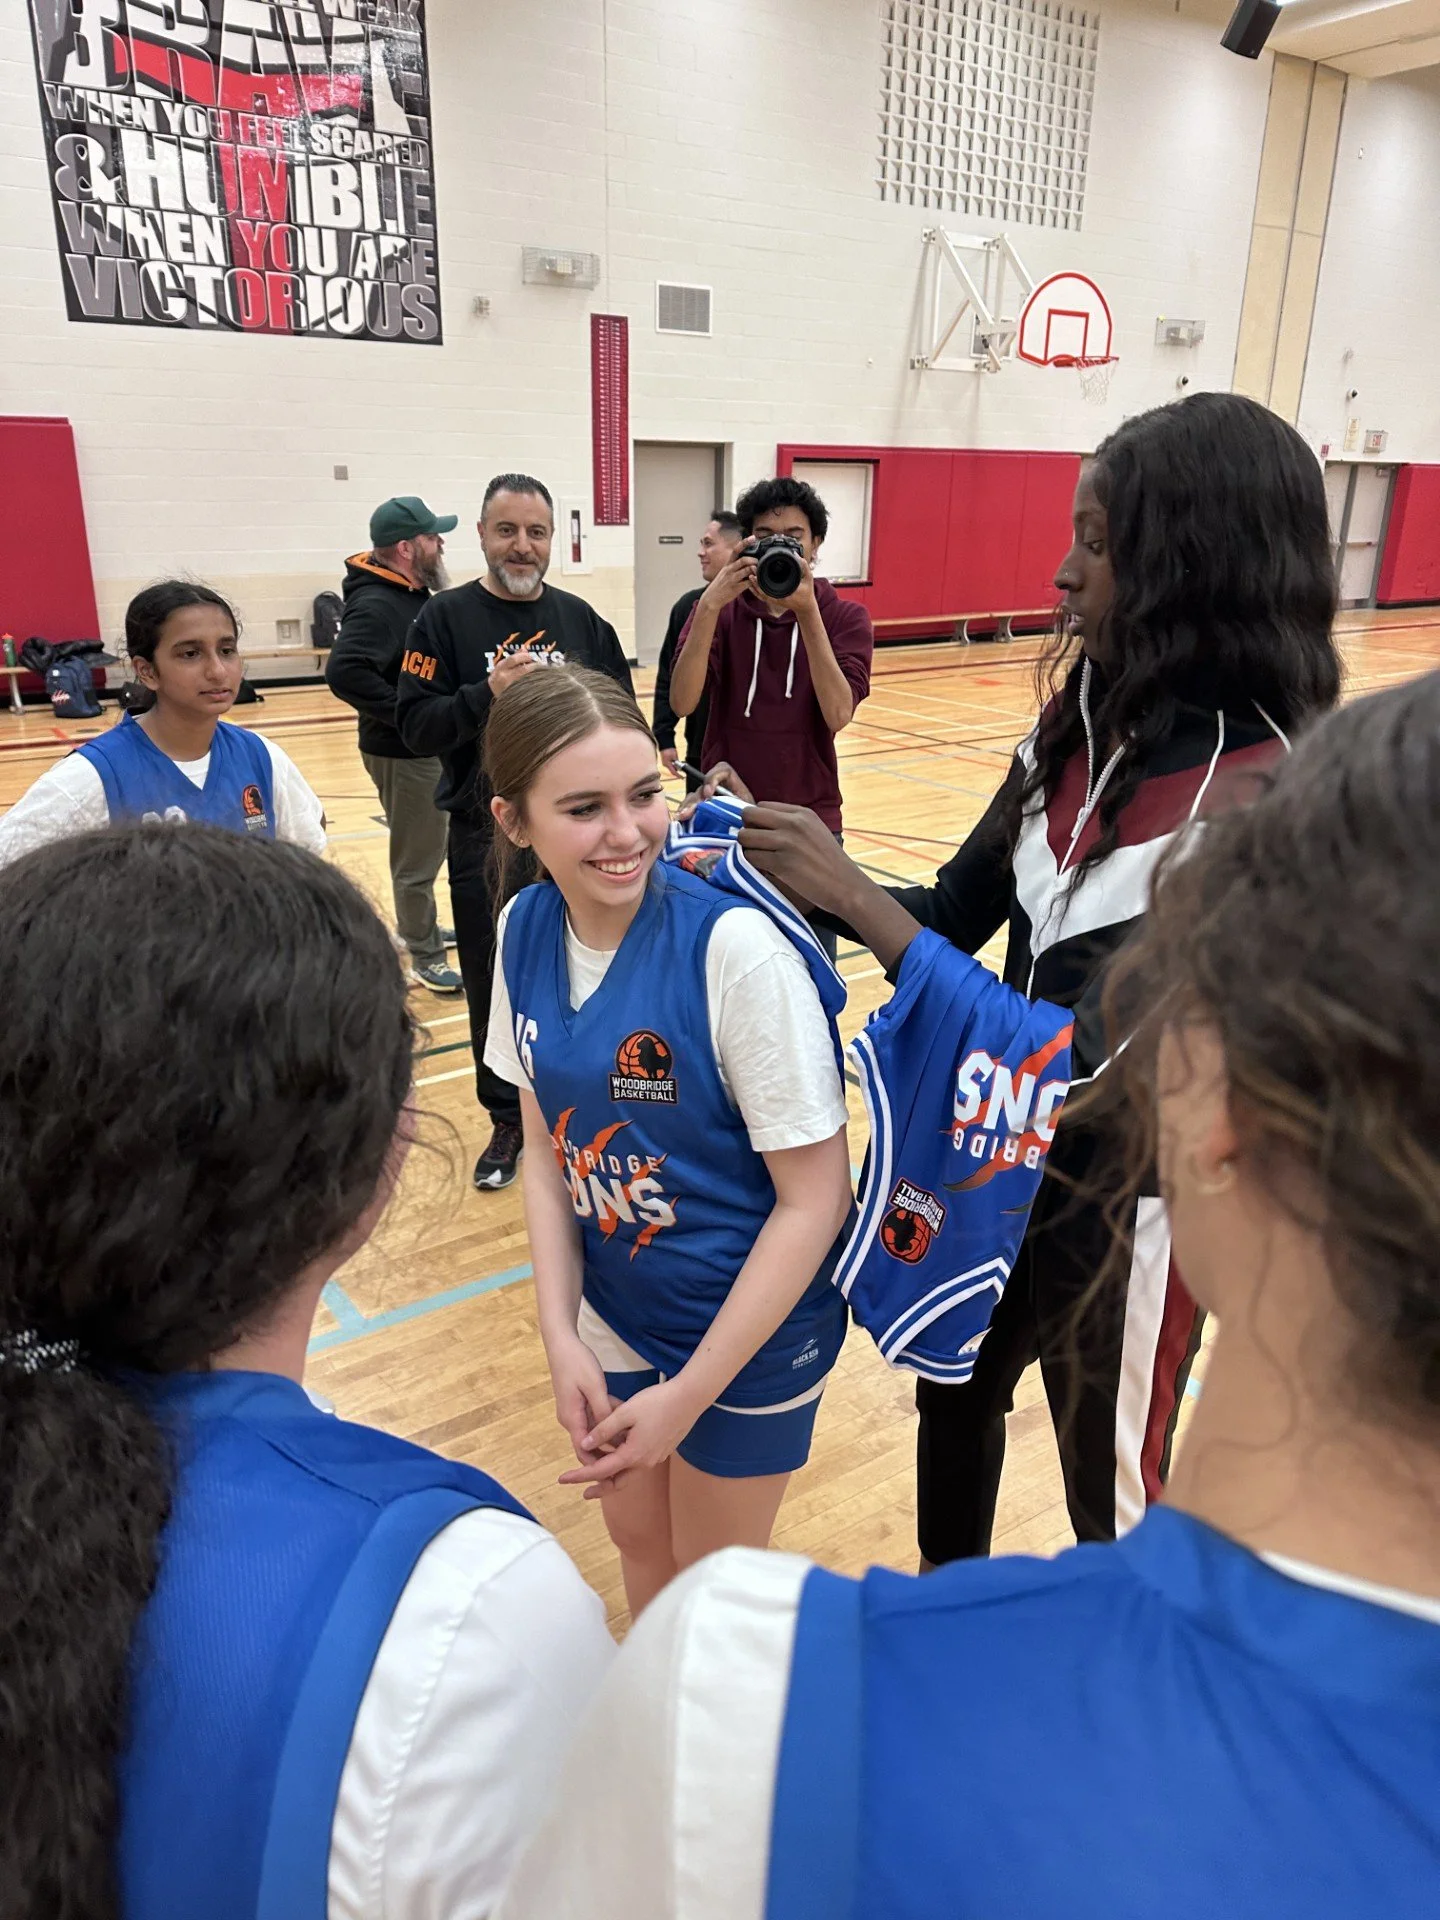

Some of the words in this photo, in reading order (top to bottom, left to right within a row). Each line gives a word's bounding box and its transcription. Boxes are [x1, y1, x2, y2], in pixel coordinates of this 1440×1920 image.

[30, 0, 429, 138] BRAVE
[43, 83, 159, 134] WHEN
[160, 100, 233, 142] YOU
[238, 112, 307, 153] FEEL
[310, 123, 430, 169] SCARED
[55, 133, 127, 206] &
[120, 128, 435, 240] HUMBLE
[58, 200, 231, 267] WHEN
[236, 219, 339, 276] YOU
[350, 231, 437, 286] ARE
[65, 253, 439, 340] VICTORIOUS
[611, 1076, 675, 1091] WOODBRIDGE
[613, 1088, 676, 1102] BASKETBALL
[893, 1192, 941, 1233] WOODBRIDGE
